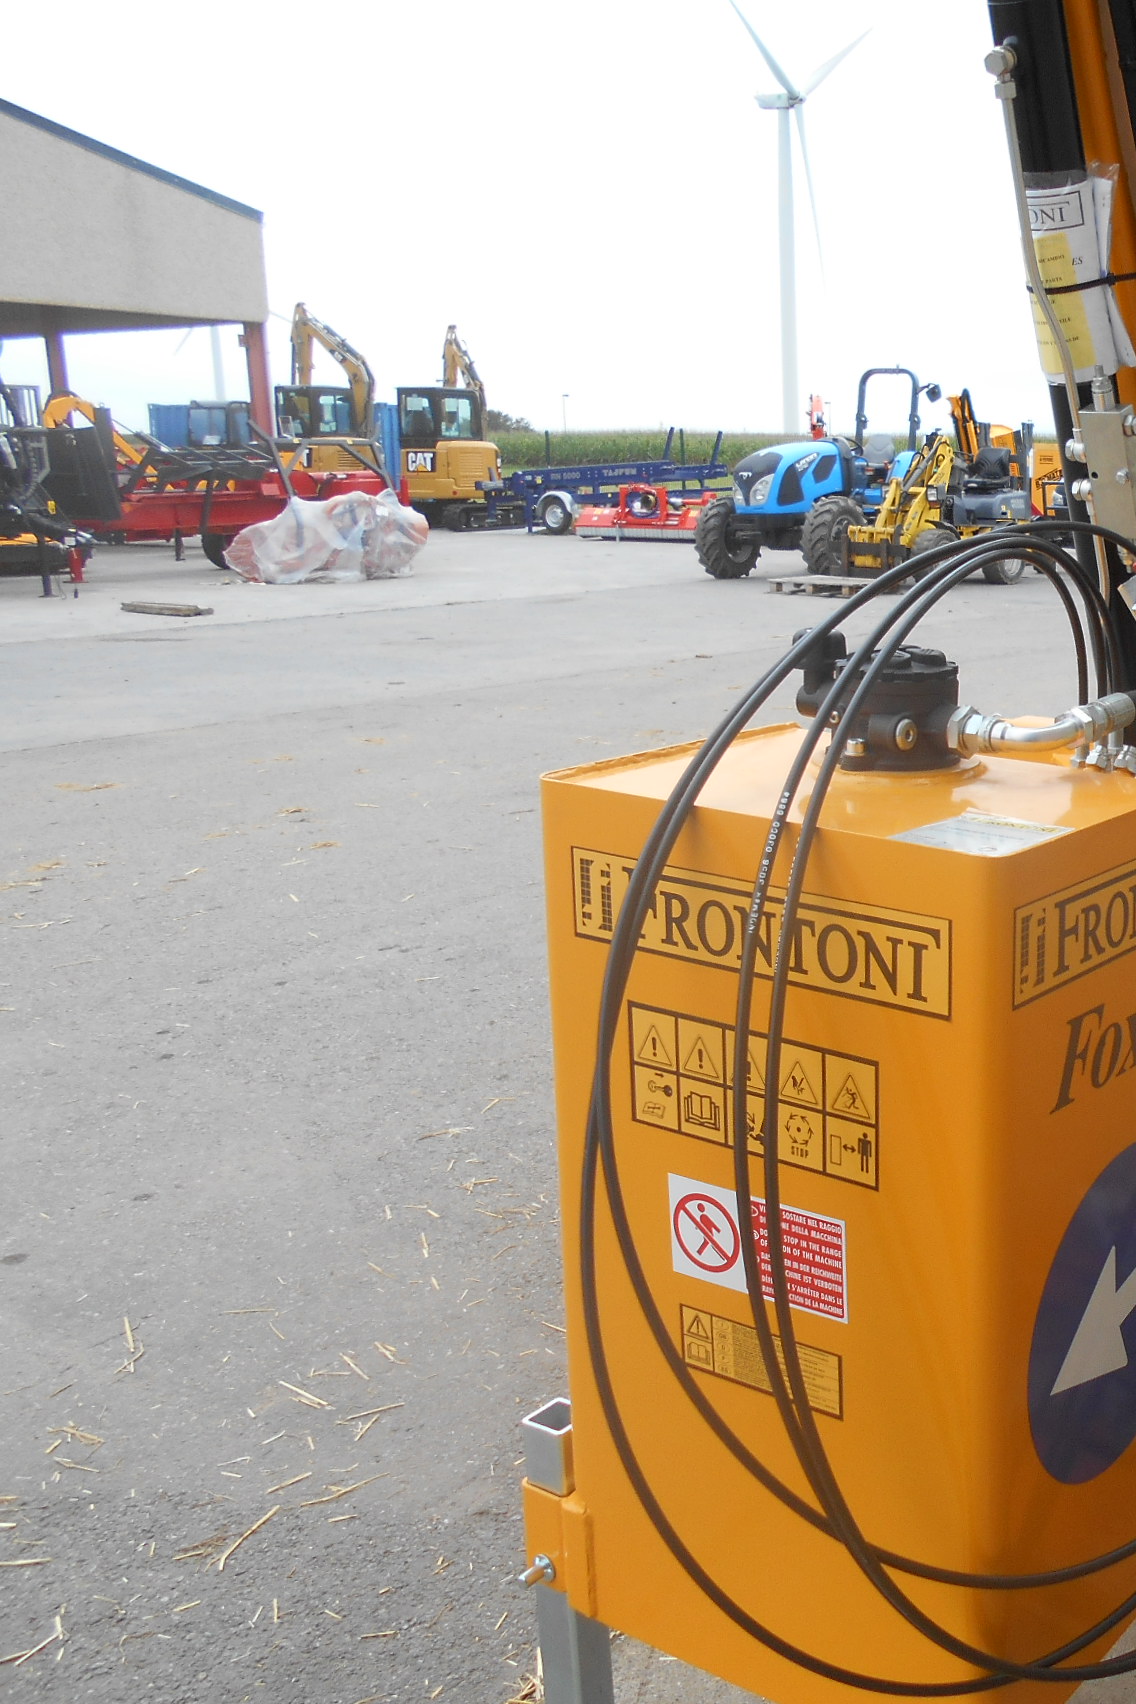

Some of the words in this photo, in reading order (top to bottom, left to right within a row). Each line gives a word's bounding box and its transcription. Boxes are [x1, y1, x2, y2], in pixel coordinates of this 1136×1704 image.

[407, 452, 434, 472] CAT
[790, 1145, 809, 1159] STOP
[782, 1211, 806, 1225] SOSTARE
[820, 1221, 842, 1234] RAGGIO
[811, 1230, 842, 1245] MACCHINA
[784, 1235, 798, 1245] STOP
[809, 1241, 820, 1252] THE
[821, 1245, 842, 1258] RANGE
[802, 1252, 813, 1262] THE
[815, 1255, 842, 1269] MACHINE
[821, 1291, 836, 1303] DANS
